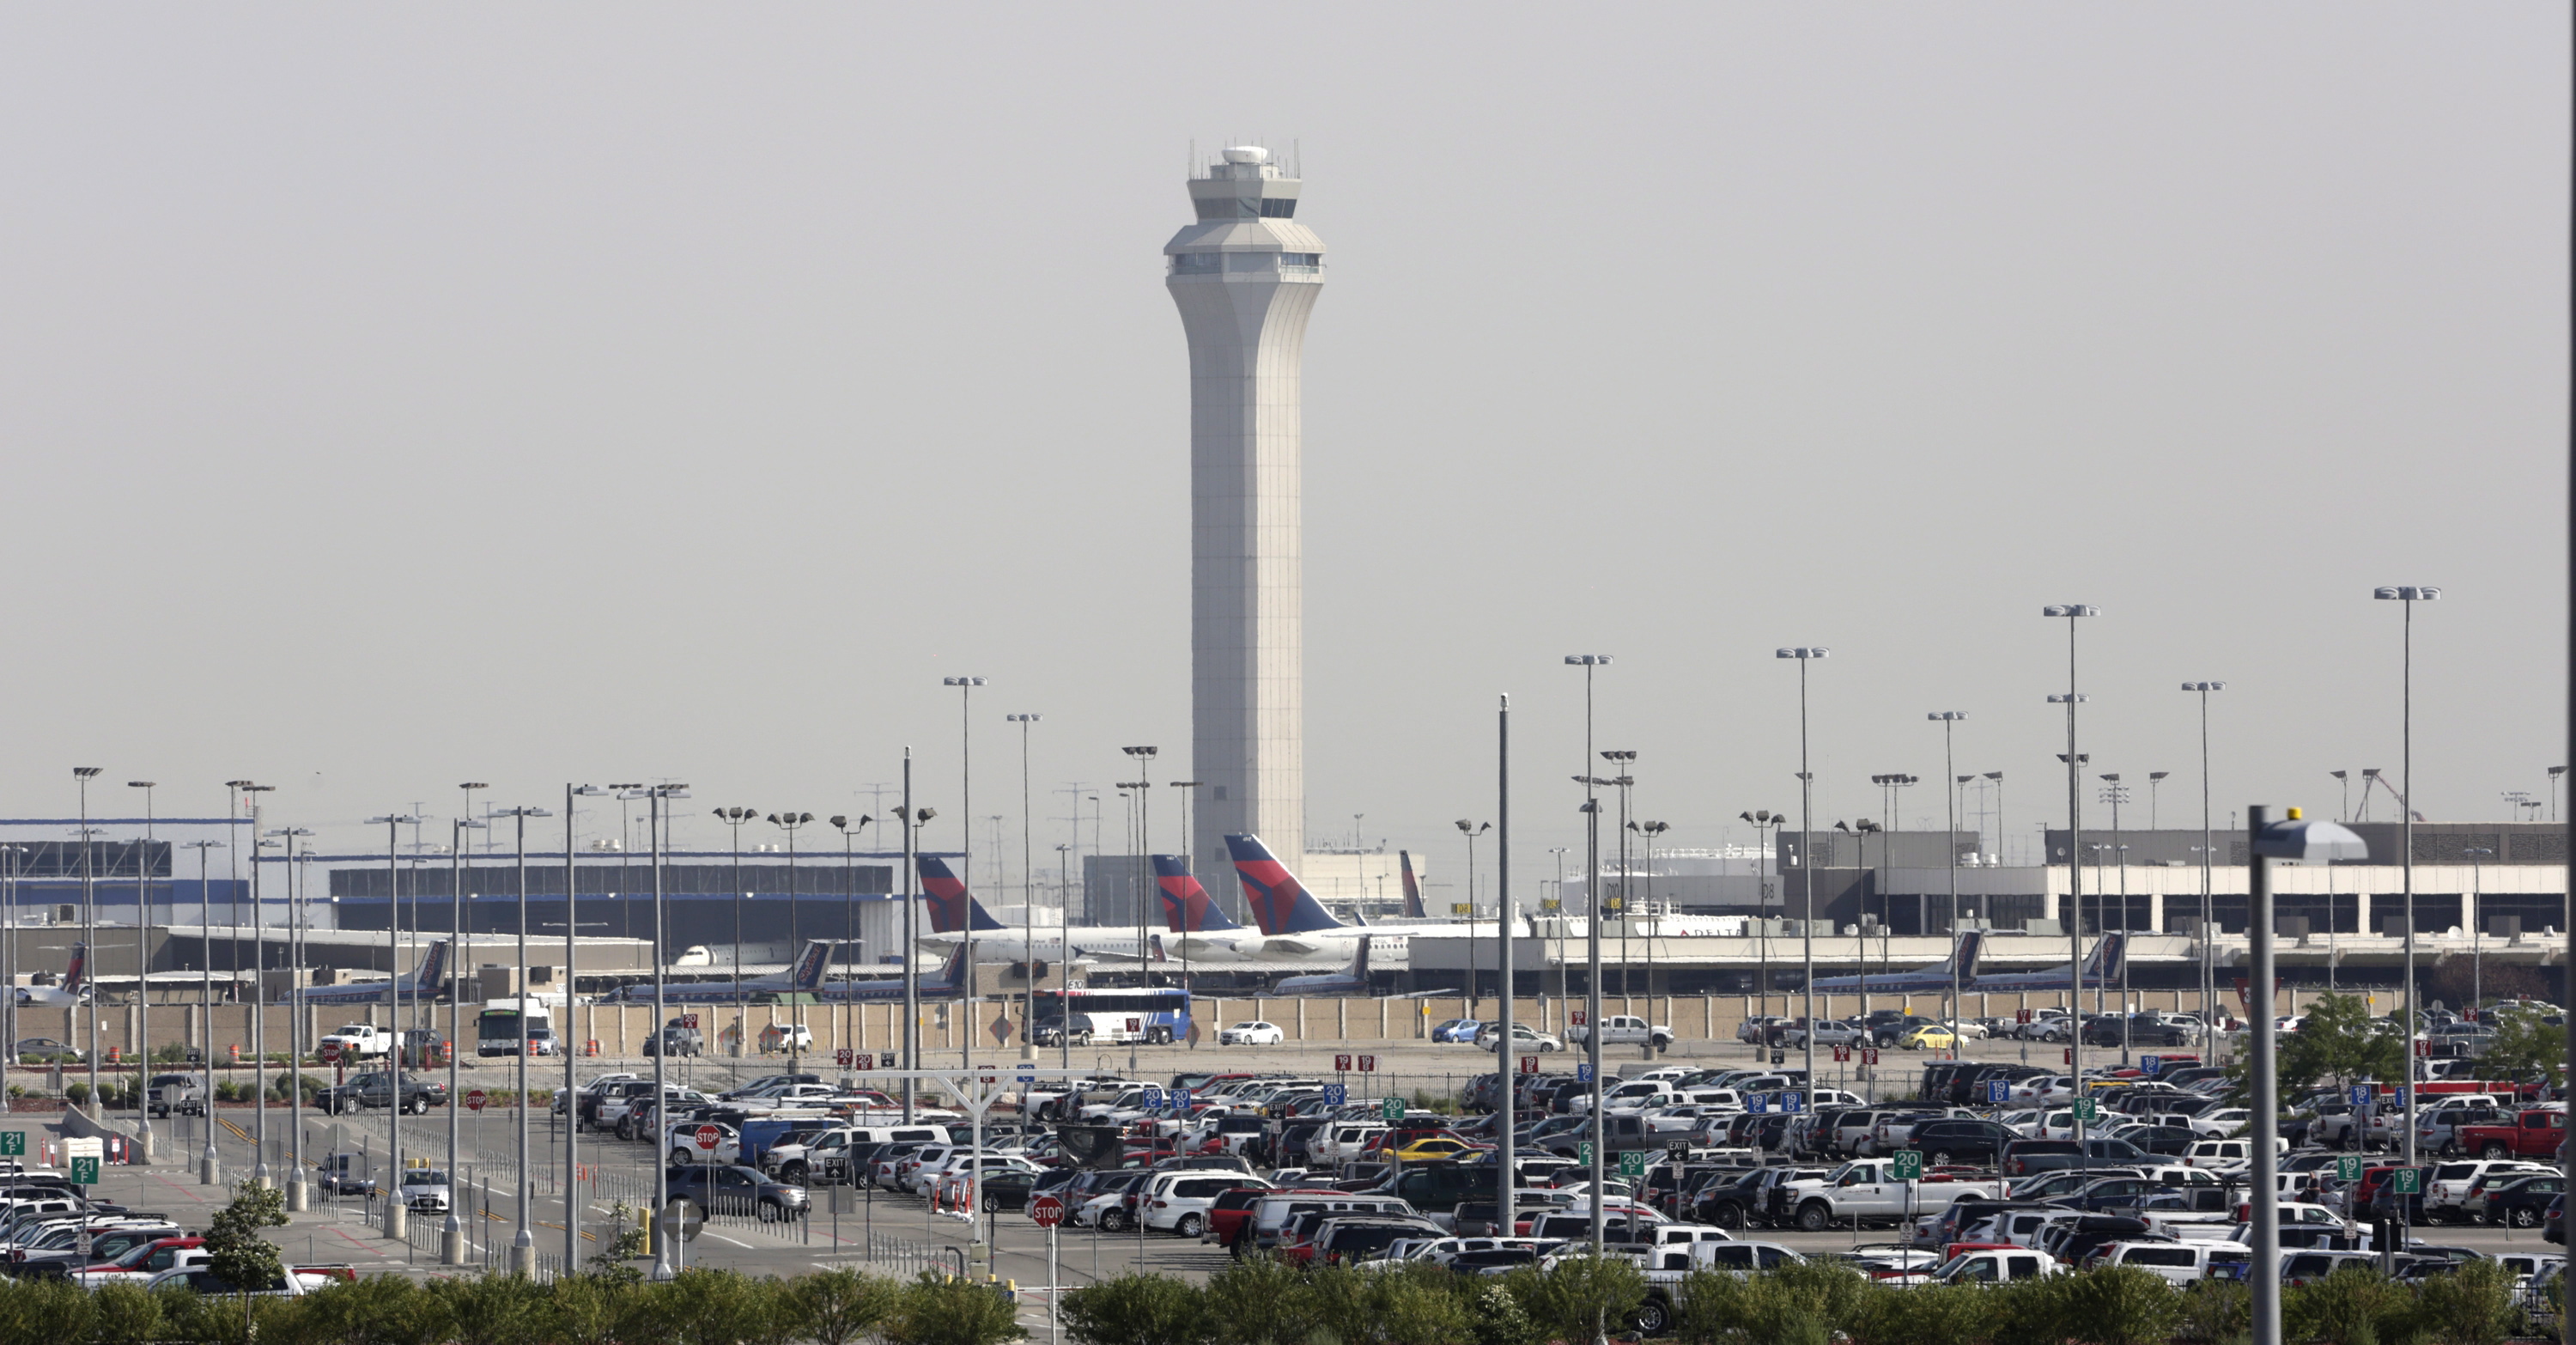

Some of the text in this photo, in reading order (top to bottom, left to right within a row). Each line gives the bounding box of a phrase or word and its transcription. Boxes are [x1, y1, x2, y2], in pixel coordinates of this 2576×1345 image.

[1607, 883, 1619, 898] D10
[1763, 884, 1774, 898] D8
[799, 945, 822, 983] SkyWest
[1067, 981, 1083, 989] E10
[1327, 1086, 1342, 1096] 20
[1993, 1082, 2005, 1092] 19
[2354, 1087, 2366, 1096] 18
[1146, 1090, 1159, 1099] 20
[1174, 1091, 1188, 1100] 20
[1785, 1094, 1796, 1103] 19
[1386, 1099, 1401, 1110] 20
[1751, 1096, 1763, 1105] 19
[2078, 1100, 2091, 1110] 19
[6, 1134, 20, 1144] 21
[697, 1133, 718, 1142] STOP
[9, 1145, 15, 1153] F
[1583, 1144, 1592, 1154] 2
[1624, 1153, 1641, 1165] 20
[1899, 1153, 1917, 1165] 20
[2342, 1159, 2356, 1169] 19
[77, 1159, 93, 1171] 21
[1904, 1166, 1911, 1176] F
[2400, 1171, 2414, 1181] 19
[82, 1172, 88, 1182] F
